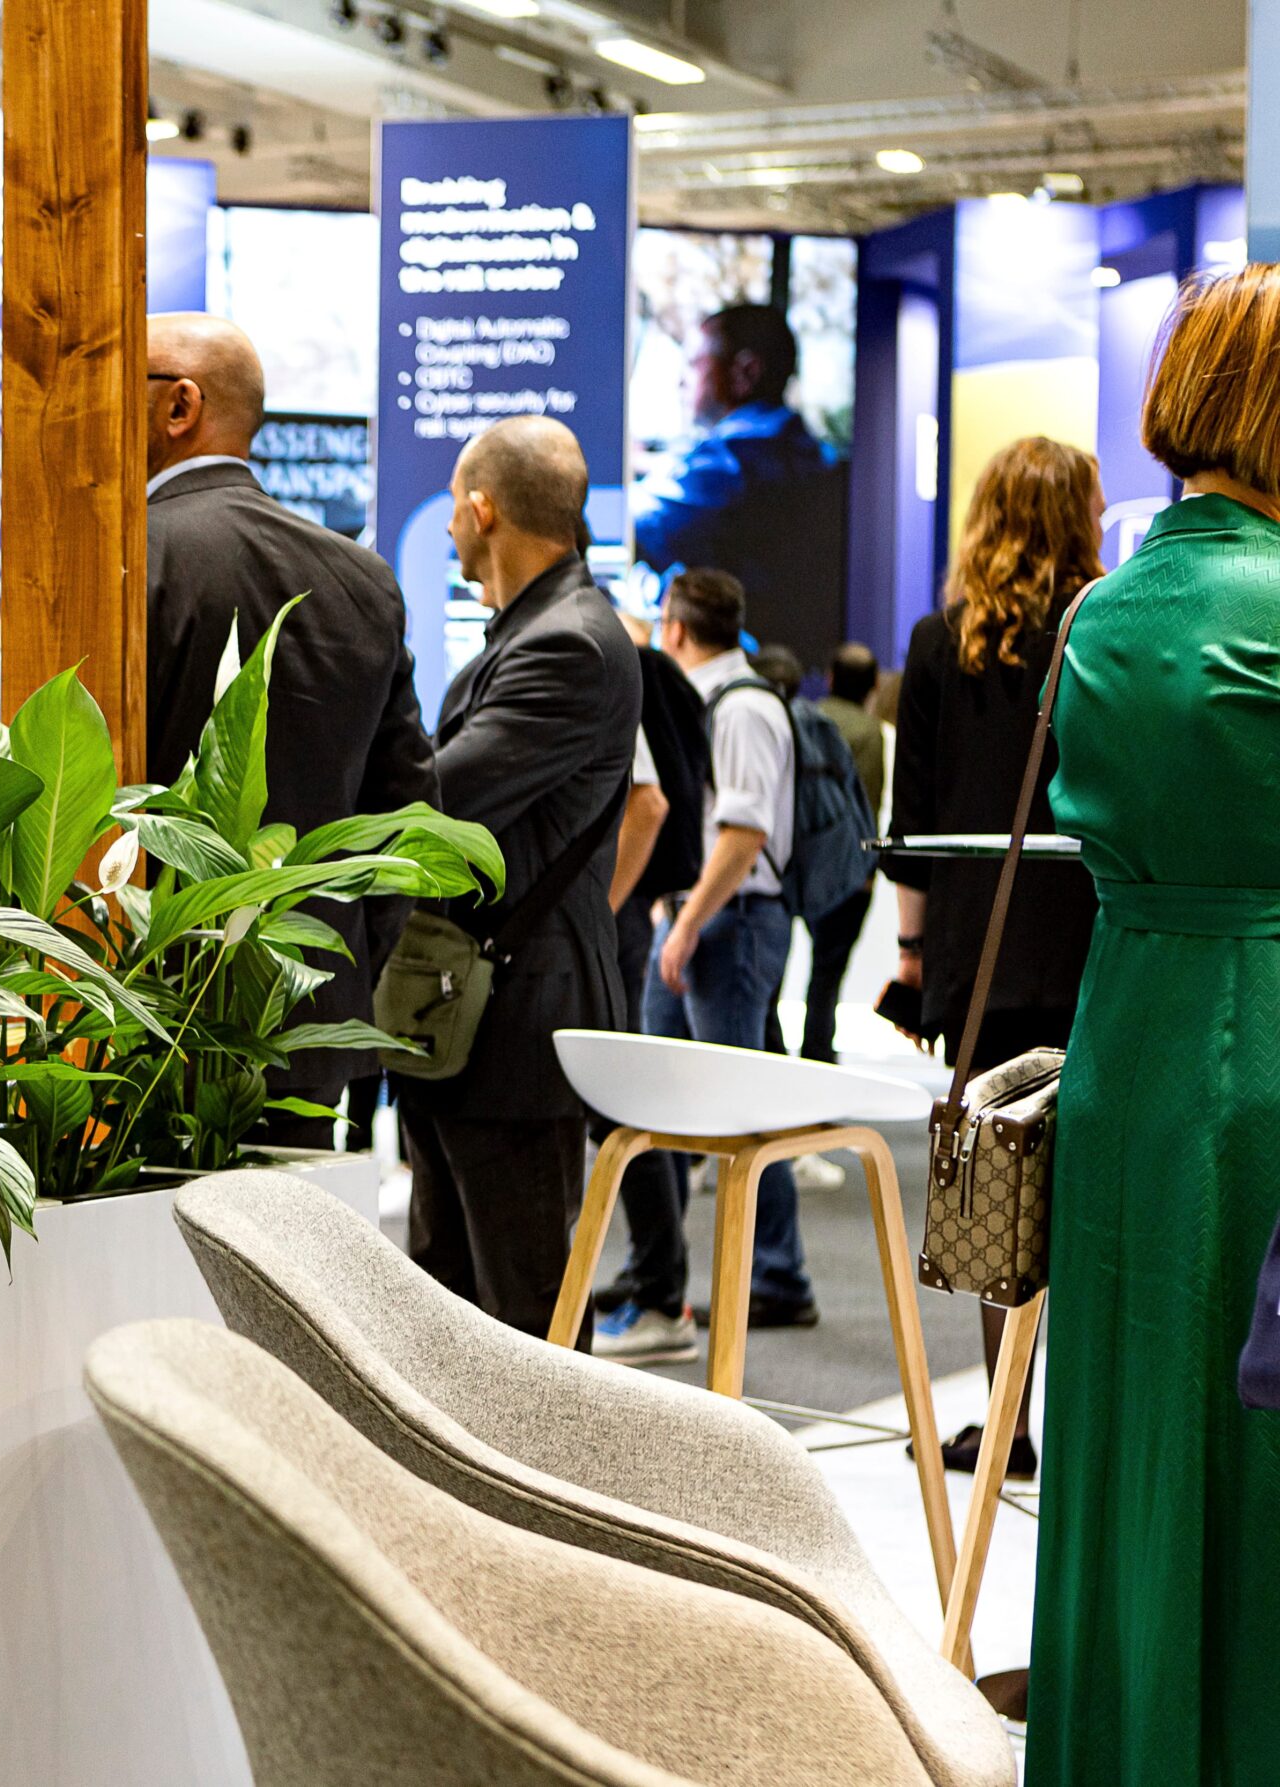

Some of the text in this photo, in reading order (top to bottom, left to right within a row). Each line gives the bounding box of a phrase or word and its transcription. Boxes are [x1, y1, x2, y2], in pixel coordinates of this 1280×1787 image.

[401, 176, 506, 207] Enabling
[572, 202, 596, 231] &
[552, 232, 578, 260] in
[399, 263, 564, 293] the rail sector
[416, 315, 570, 344] Digital Automatic
[415, 340, 498, 369] Coupling
[415, 387, 578, 418] Cyber security for
